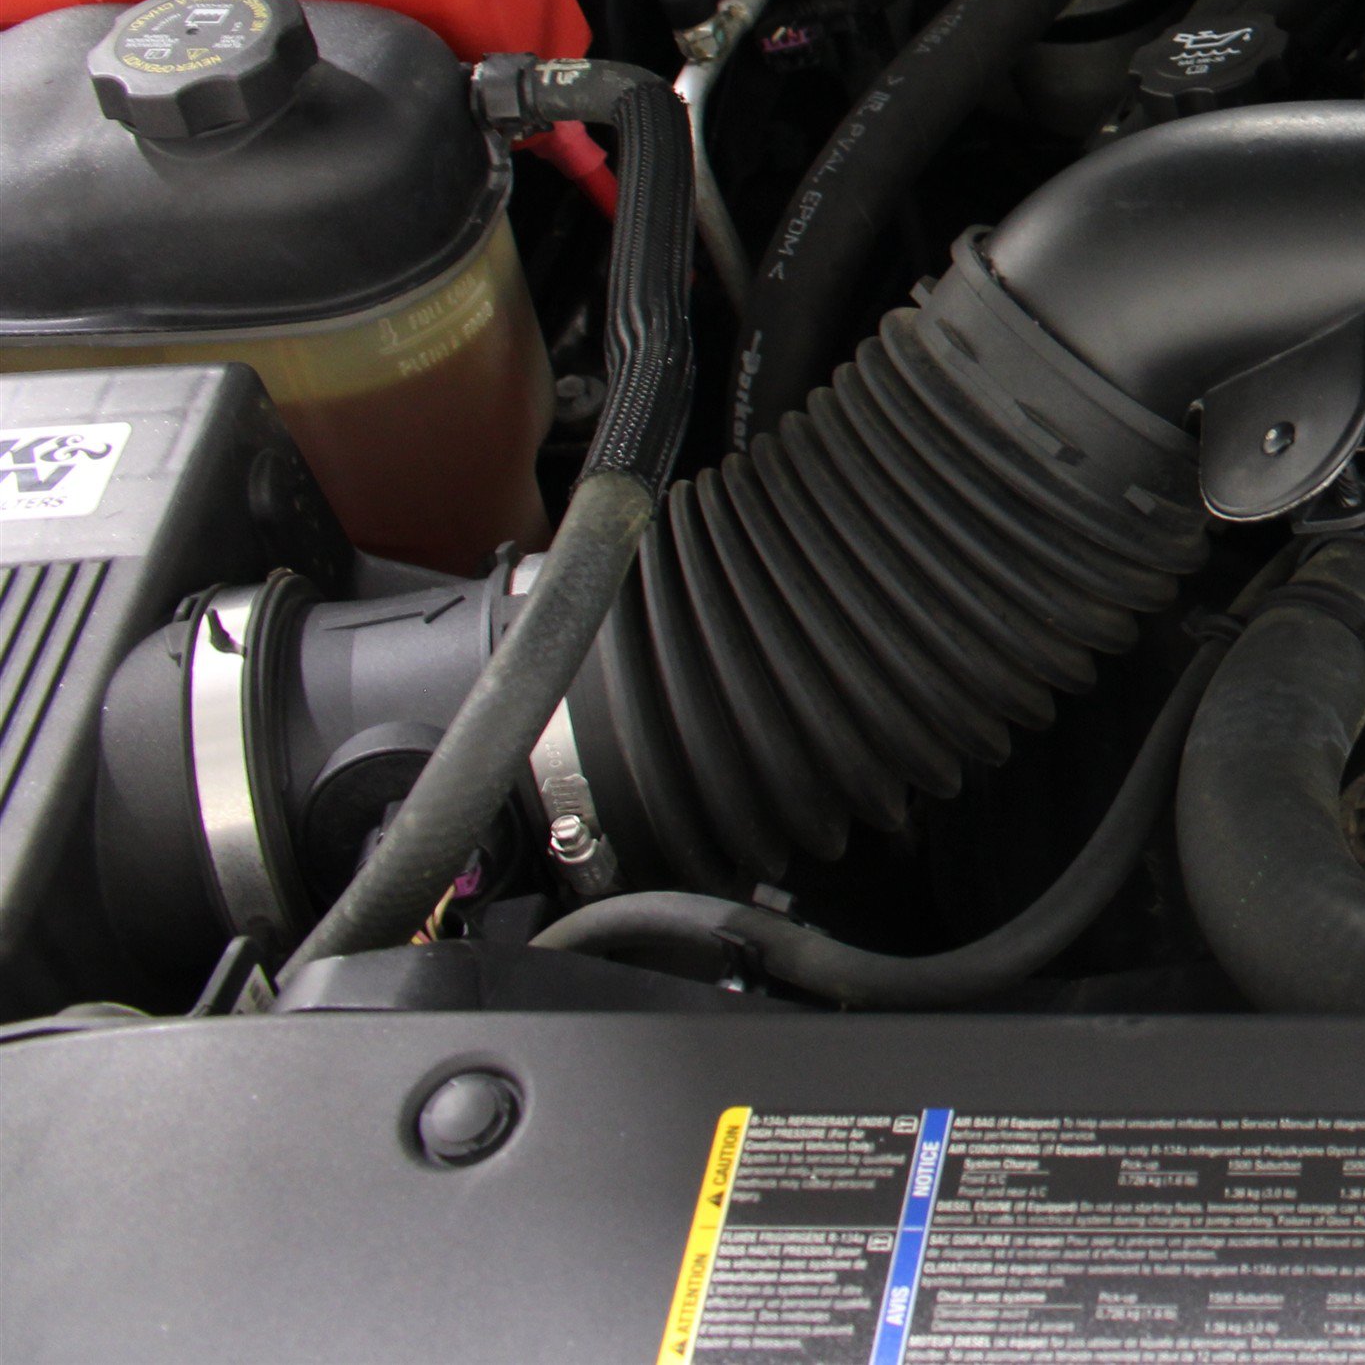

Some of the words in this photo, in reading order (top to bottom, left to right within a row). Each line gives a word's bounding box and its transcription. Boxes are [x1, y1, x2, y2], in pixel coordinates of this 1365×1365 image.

[953, 1116, 973, 1129] AIR
[1240, 1118, 1278, 1130] Service
[1278, 1118, 1317, 1130] Manual
[713, 1125, 740, 1187] CAUTION
[913, 1141, 940, 1198] NOTICE
[947, 1143, 967, 1155] AIR
[963, 1158, 1001, 1171] System
[679, 1253, 708, 1334] ATTENTION
[886, 1286, 911, 1327] AVIS
